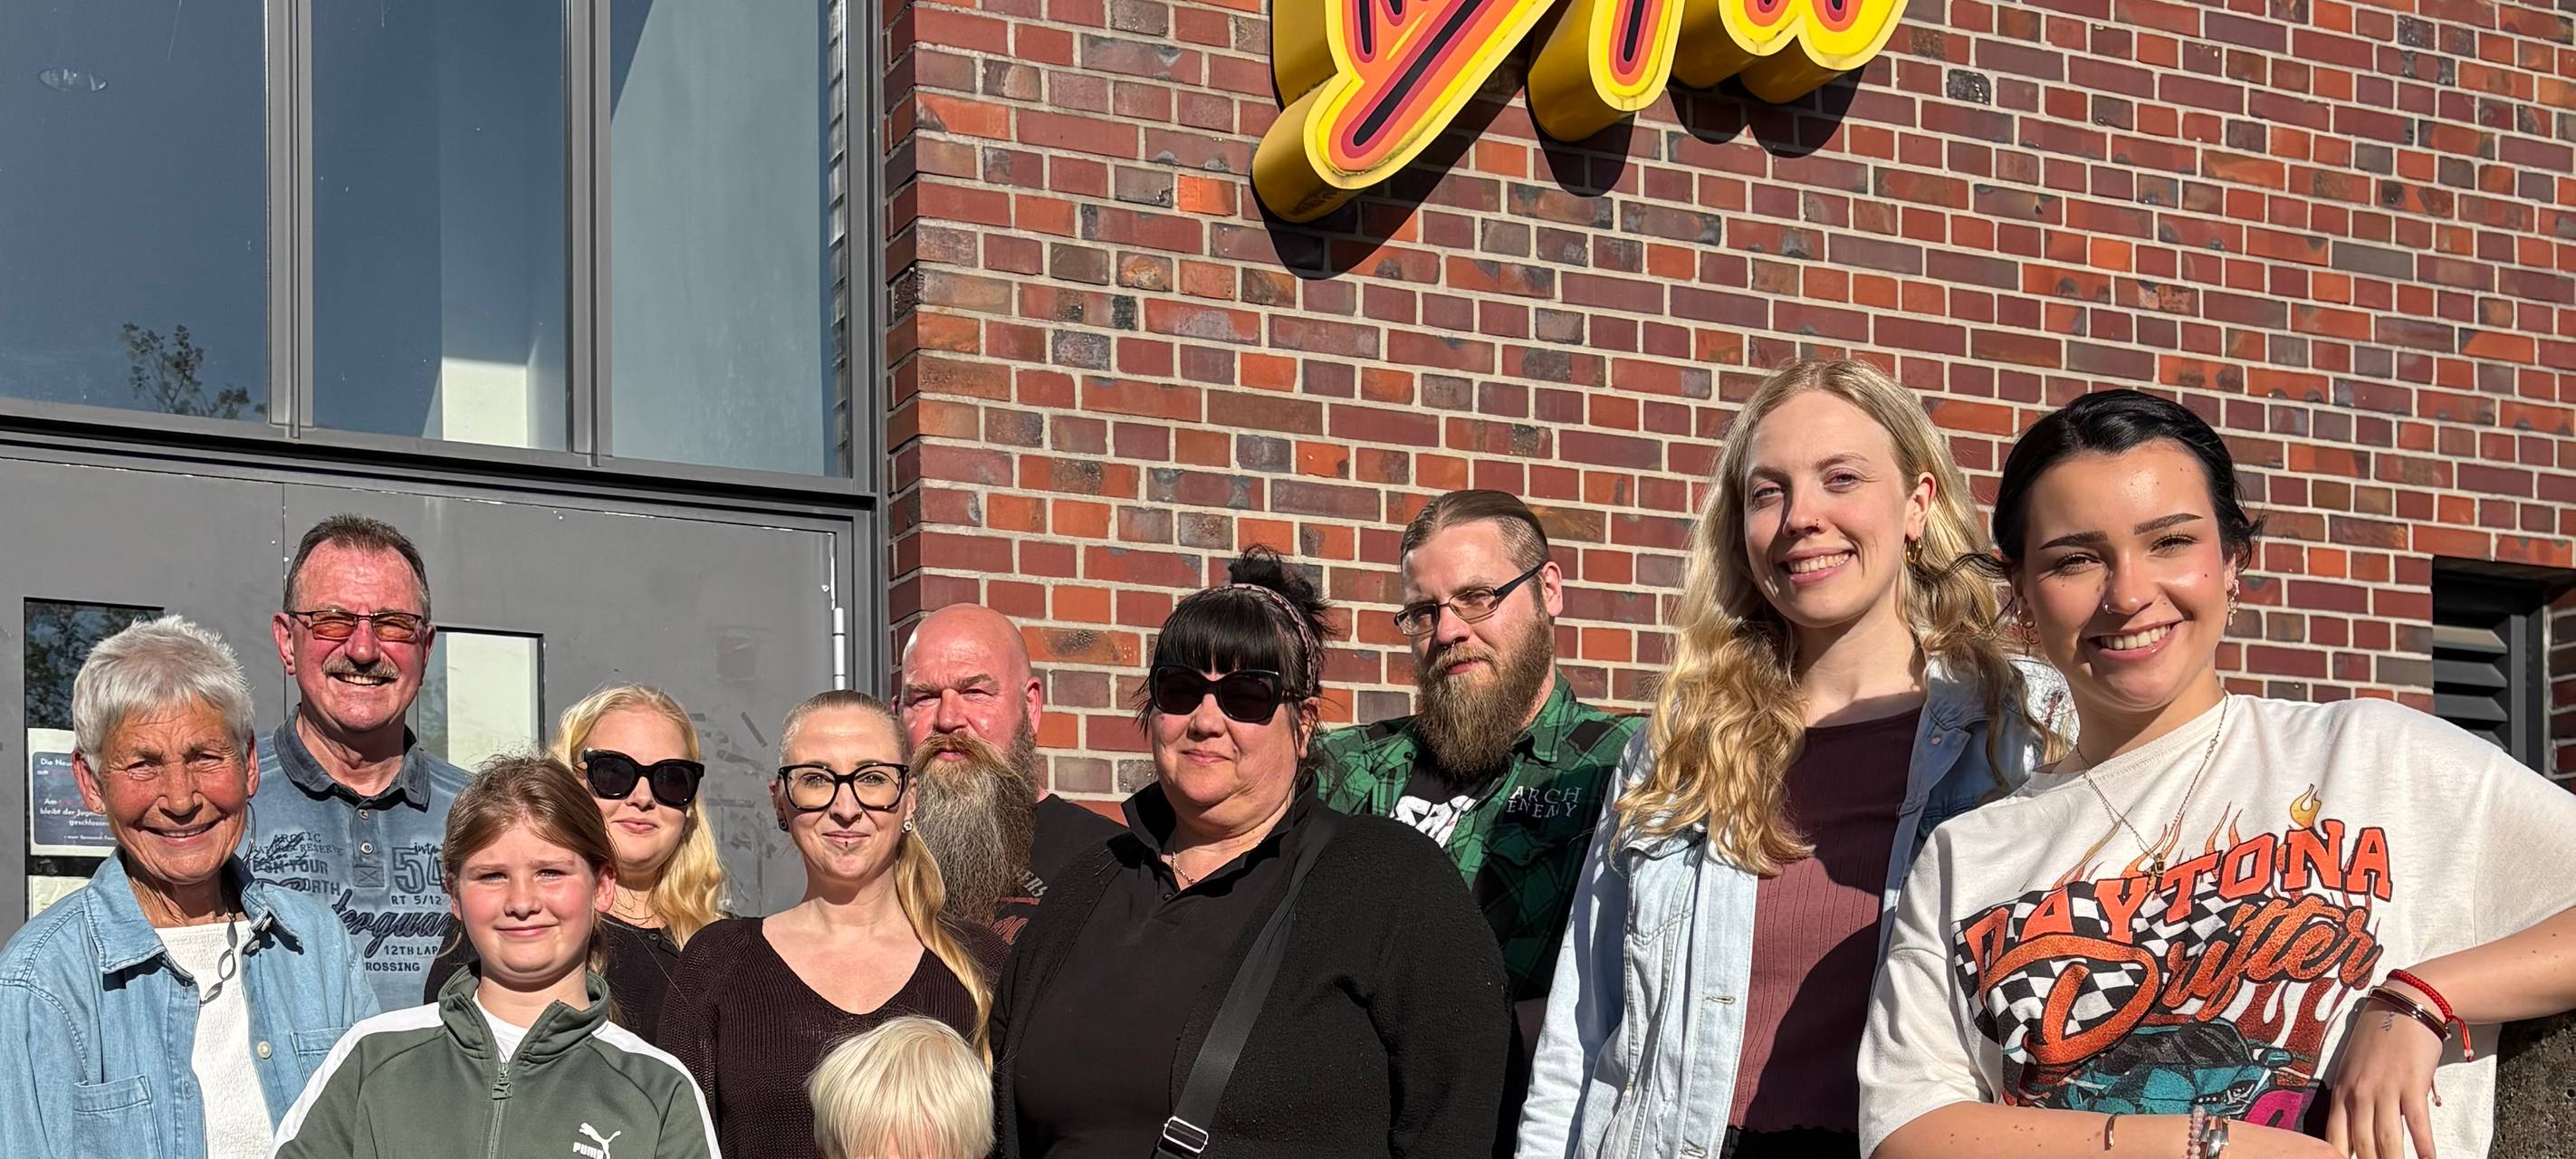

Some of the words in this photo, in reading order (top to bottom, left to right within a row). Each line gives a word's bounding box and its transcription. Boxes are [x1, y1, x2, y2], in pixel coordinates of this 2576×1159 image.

[1508, 785, 1583, 804] ARCH
[1506, 798, 1577, 819] ENEMY
[391, 896, 406, 905] RT
[414, 896, 442, 905] 5/12
[1963, 819, 2393, 980] DAYTONA
[384, 945, 414, 955] 12TH
[365, 962, 421, 972] ROSSING
[1979, 894, 2384, 1066] Drifter
[572, 1141, 605, 1159] PUMA
